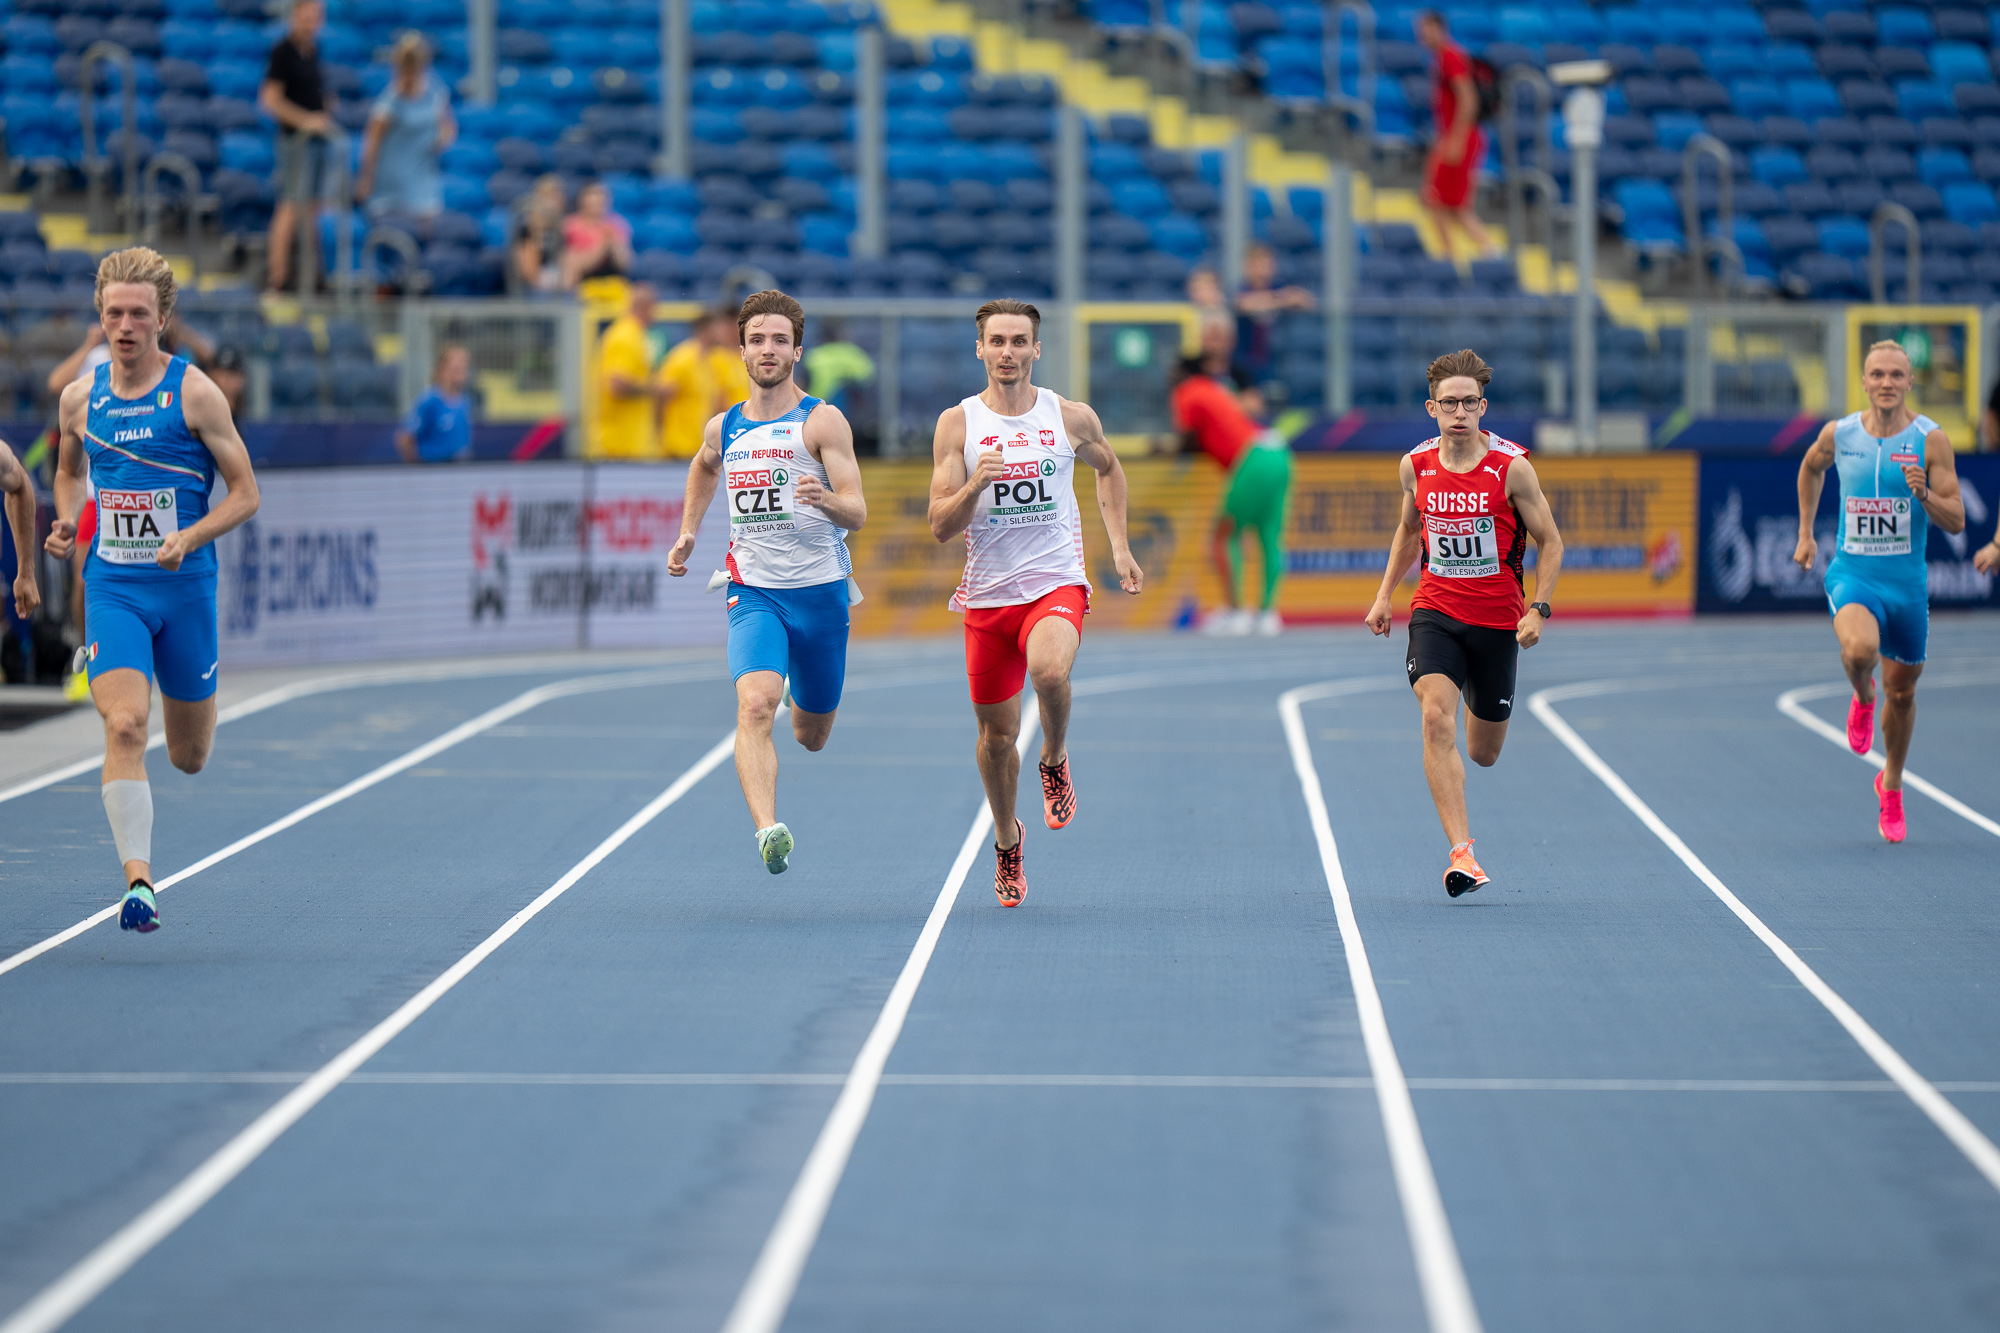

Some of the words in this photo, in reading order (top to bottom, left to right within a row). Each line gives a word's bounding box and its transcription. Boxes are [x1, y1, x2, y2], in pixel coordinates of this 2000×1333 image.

[114, 427, 153, 442] ITALIA
[980, 436, 999, 446] 4F
[726, 450, 750, 462] CZECH
[752, 449, 794, 459] REPUBLIC
[1000, 463, 1038, 478] PAR
[729, 472, 770, 487] SPAR
[994, 479, 1052, 506] POL
[102, 492, 151, 509] SPAR
[735, 488, 783, 514] CZE
[1848, 500, 1891, 513] SPAR
[1021, 504, 1045, 513] CLEAN
[755, 514, 778, 522] CLEAN
[1009, 515, 1041, 525] SILESIA
[1041, 512, 1057, 522] 2023
[113, 513, 160, 538] ITA
[746, 524, 776, 533] SILESIA
[776, 522, 795, 531] 2023
[1427, 519, 1473, 534] SPAR
[1857, 516, 1897, 535] FIN
[133, 540, 158, 548] CLEAN
[1438, 536, 1482, 558] SUI
[1864, 544, 1891, 553] SILESIA
[122, 551, 154, 560] SILESIA
[1478, 566, 1498, 575] 2023
